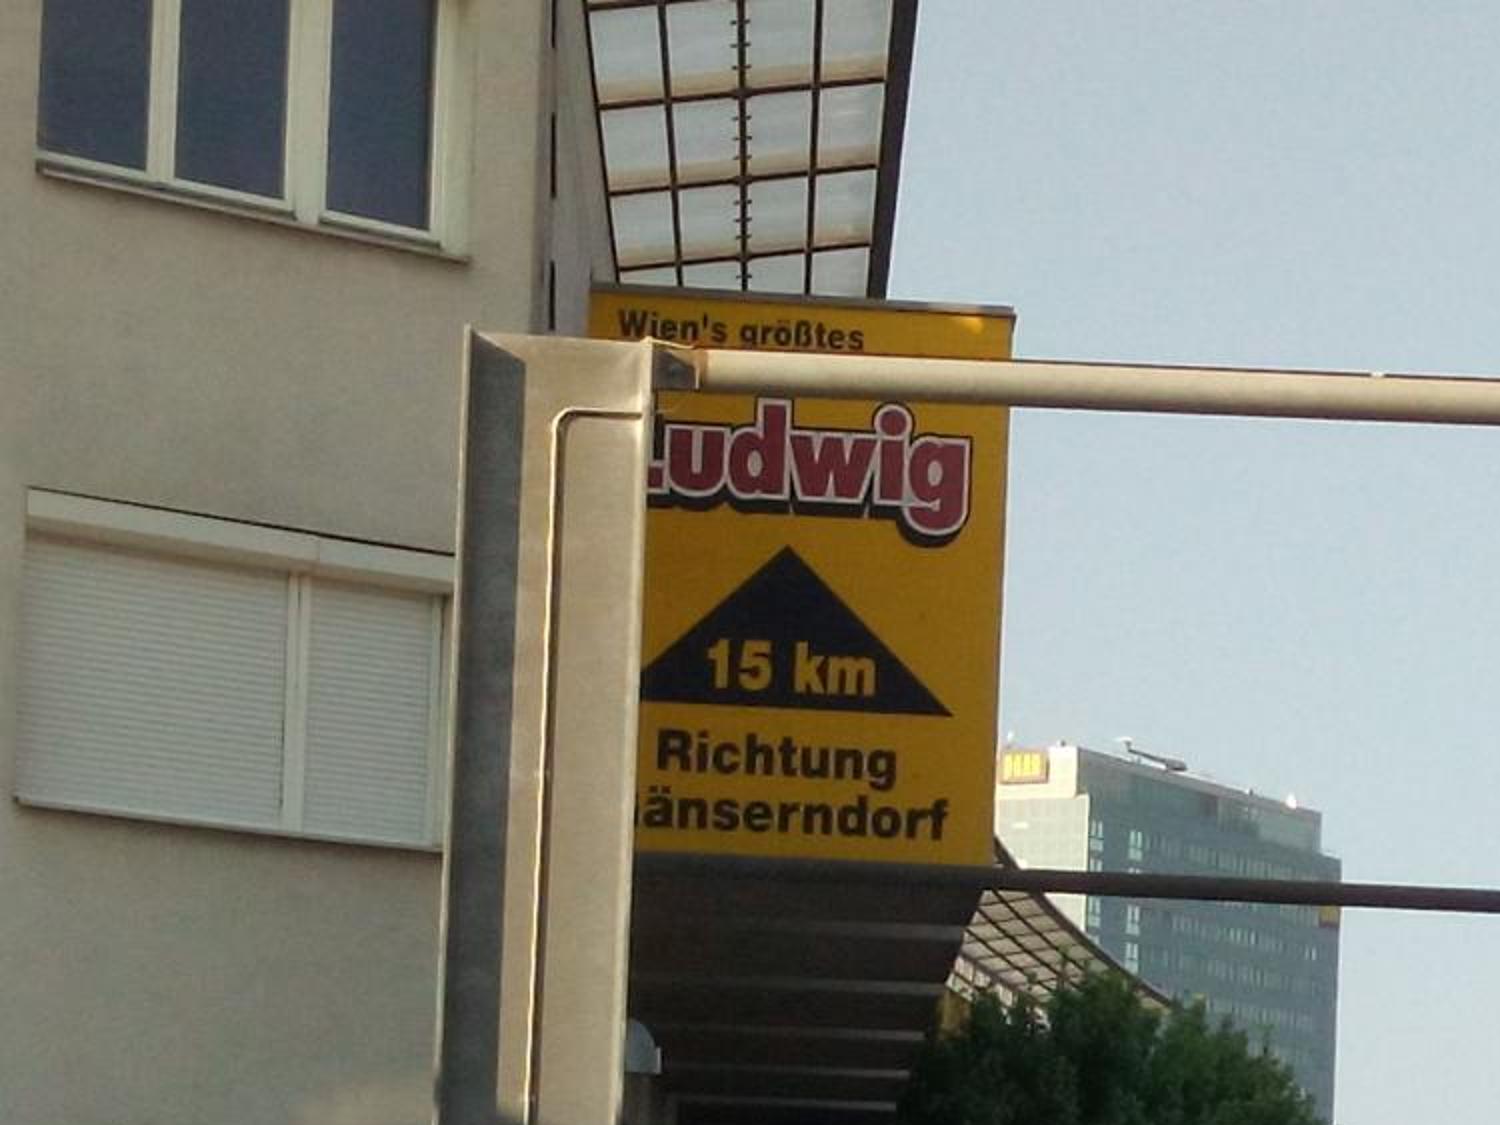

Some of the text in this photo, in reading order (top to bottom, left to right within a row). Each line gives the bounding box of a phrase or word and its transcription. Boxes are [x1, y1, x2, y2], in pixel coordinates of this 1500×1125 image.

[618, 310, 865, 351] Wien's größtes
[707, 639, 876, 697] 15 km
[656, 728, 898, 790] Richtung
[634, 785, 950, 841] änserndorf
